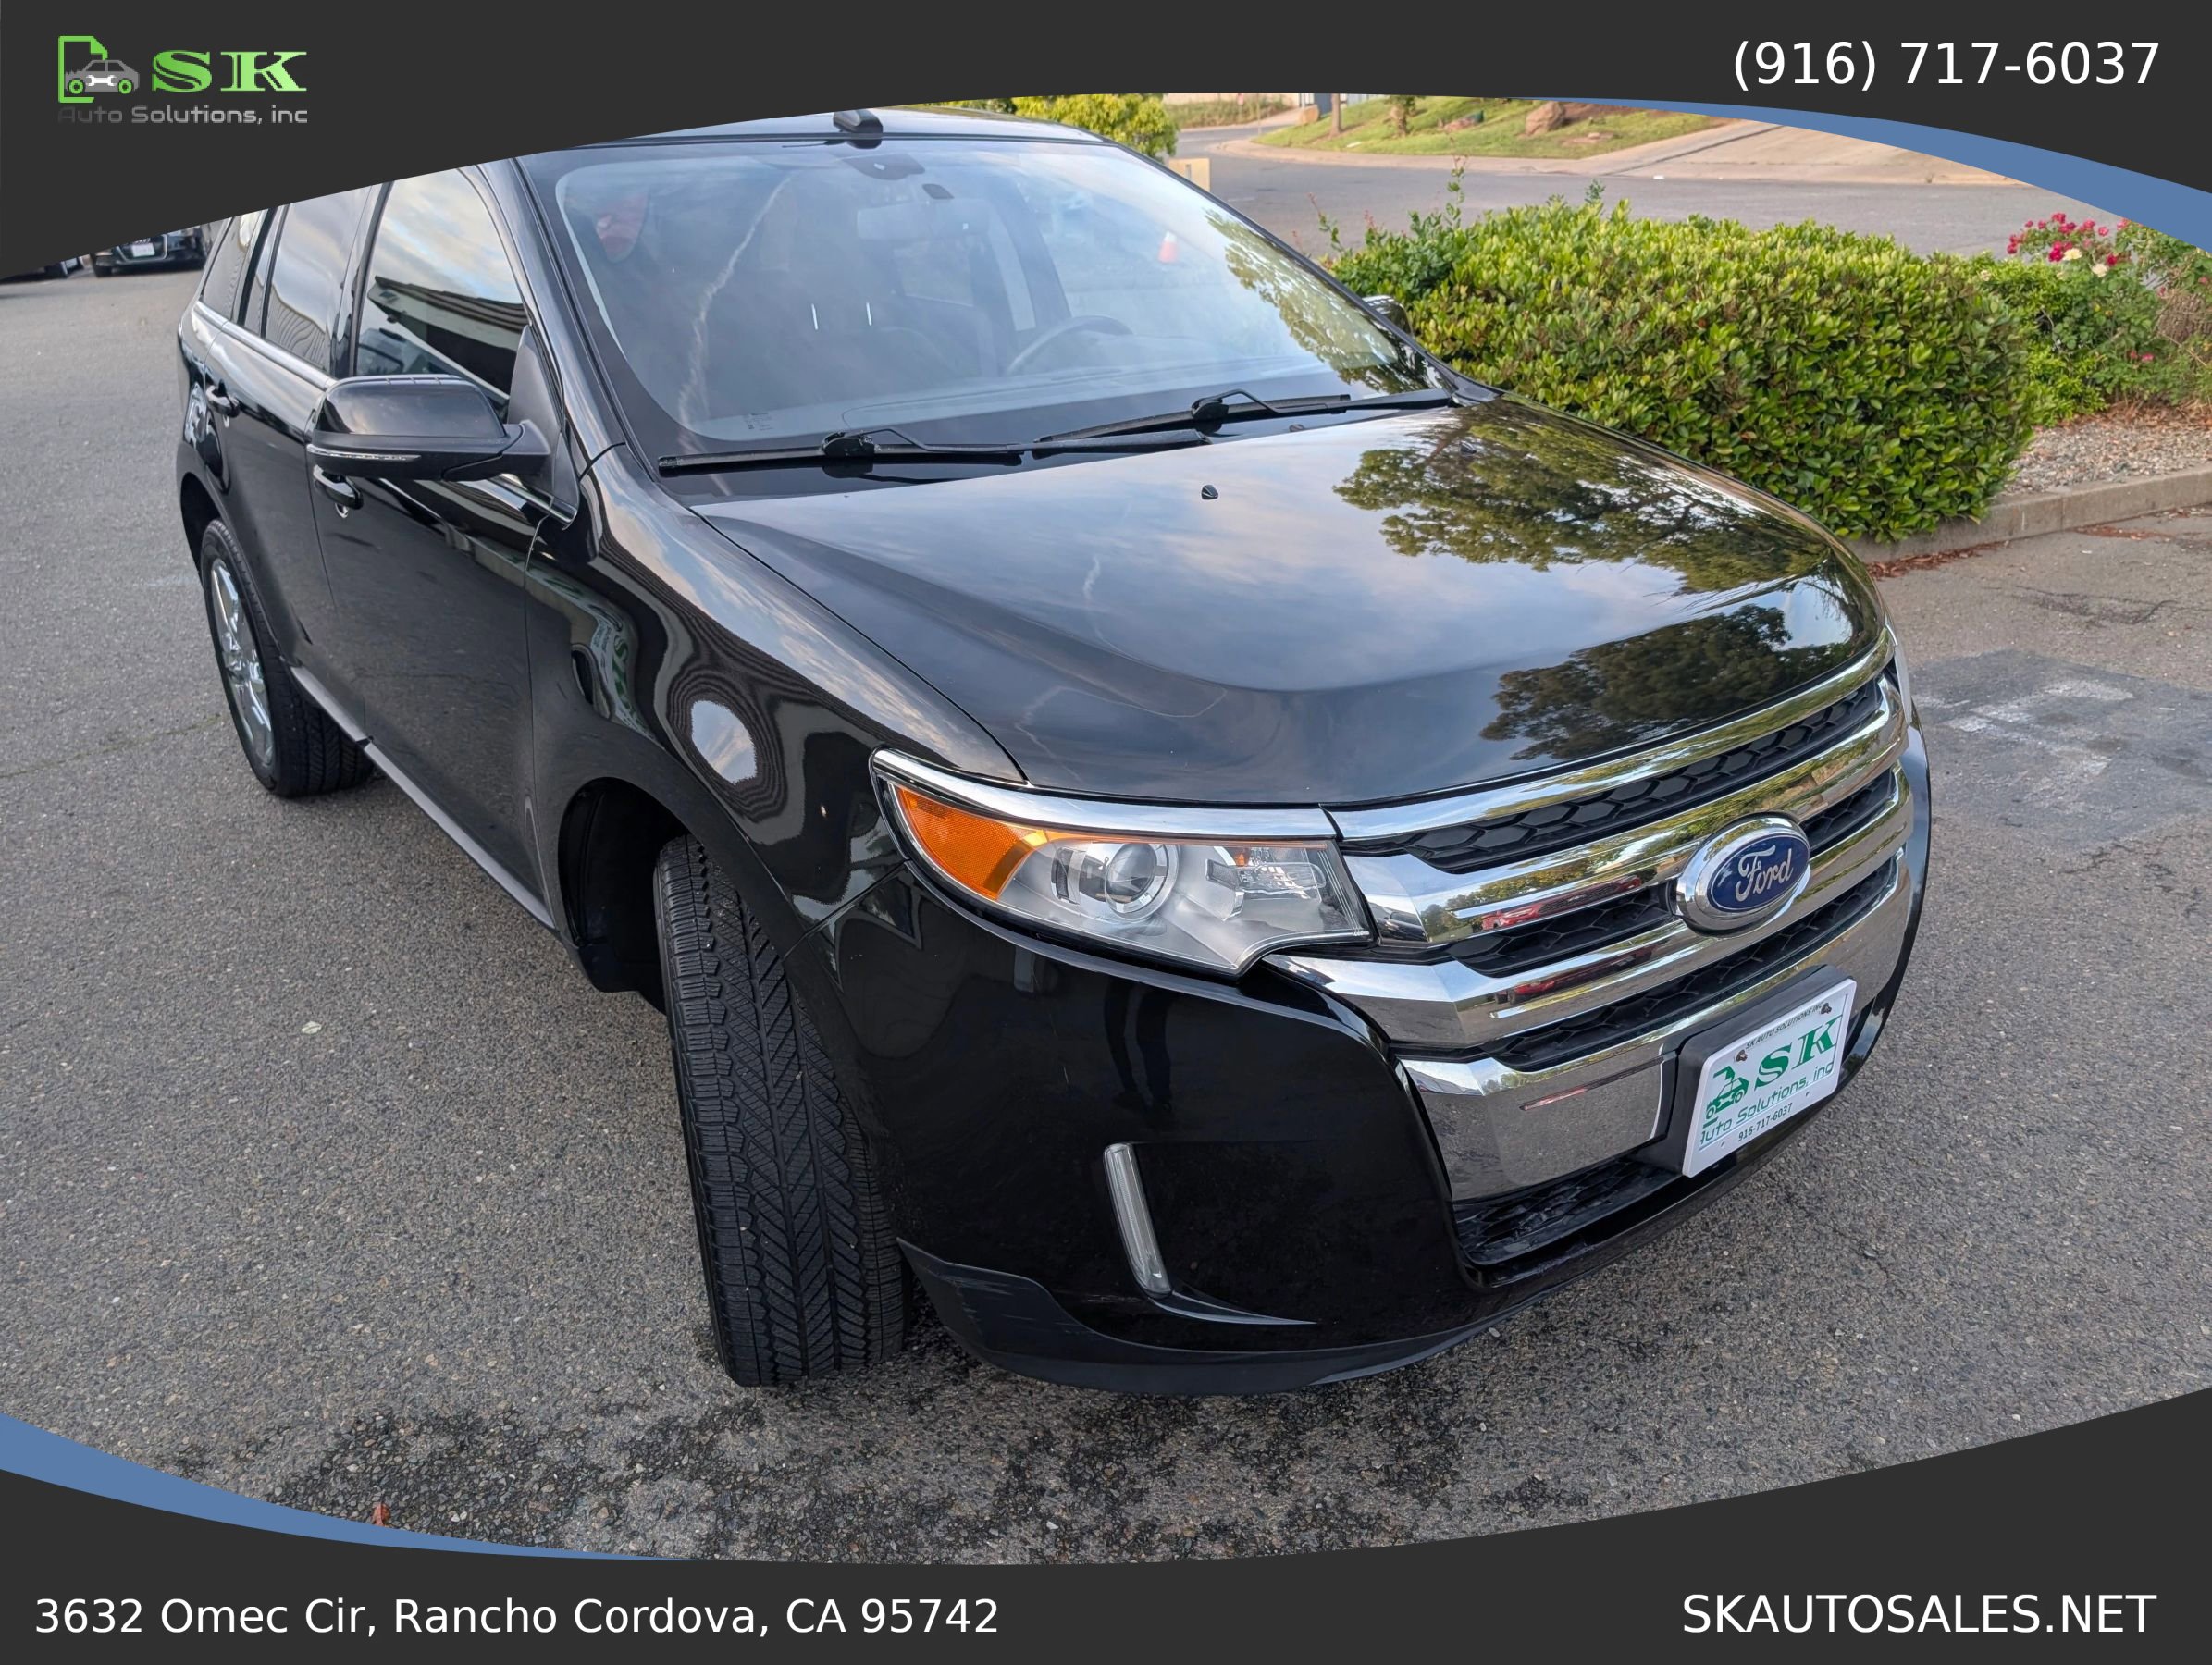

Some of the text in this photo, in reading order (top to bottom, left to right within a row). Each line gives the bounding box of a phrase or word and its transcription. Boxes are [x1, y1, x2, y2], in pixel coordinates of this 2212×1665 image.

[1735, 844, 1794, 902] Ford
[1756, 1028, 1775, 1044] AUTO
[1775, 1008, 1813, 1034] SOLUTIONS
[1754, 1015, 1843, 1092] SK
[1736, 1077, 1810, 1125] Solutions,
[1738, 1102, 1793, 1142] 916-717-6037
